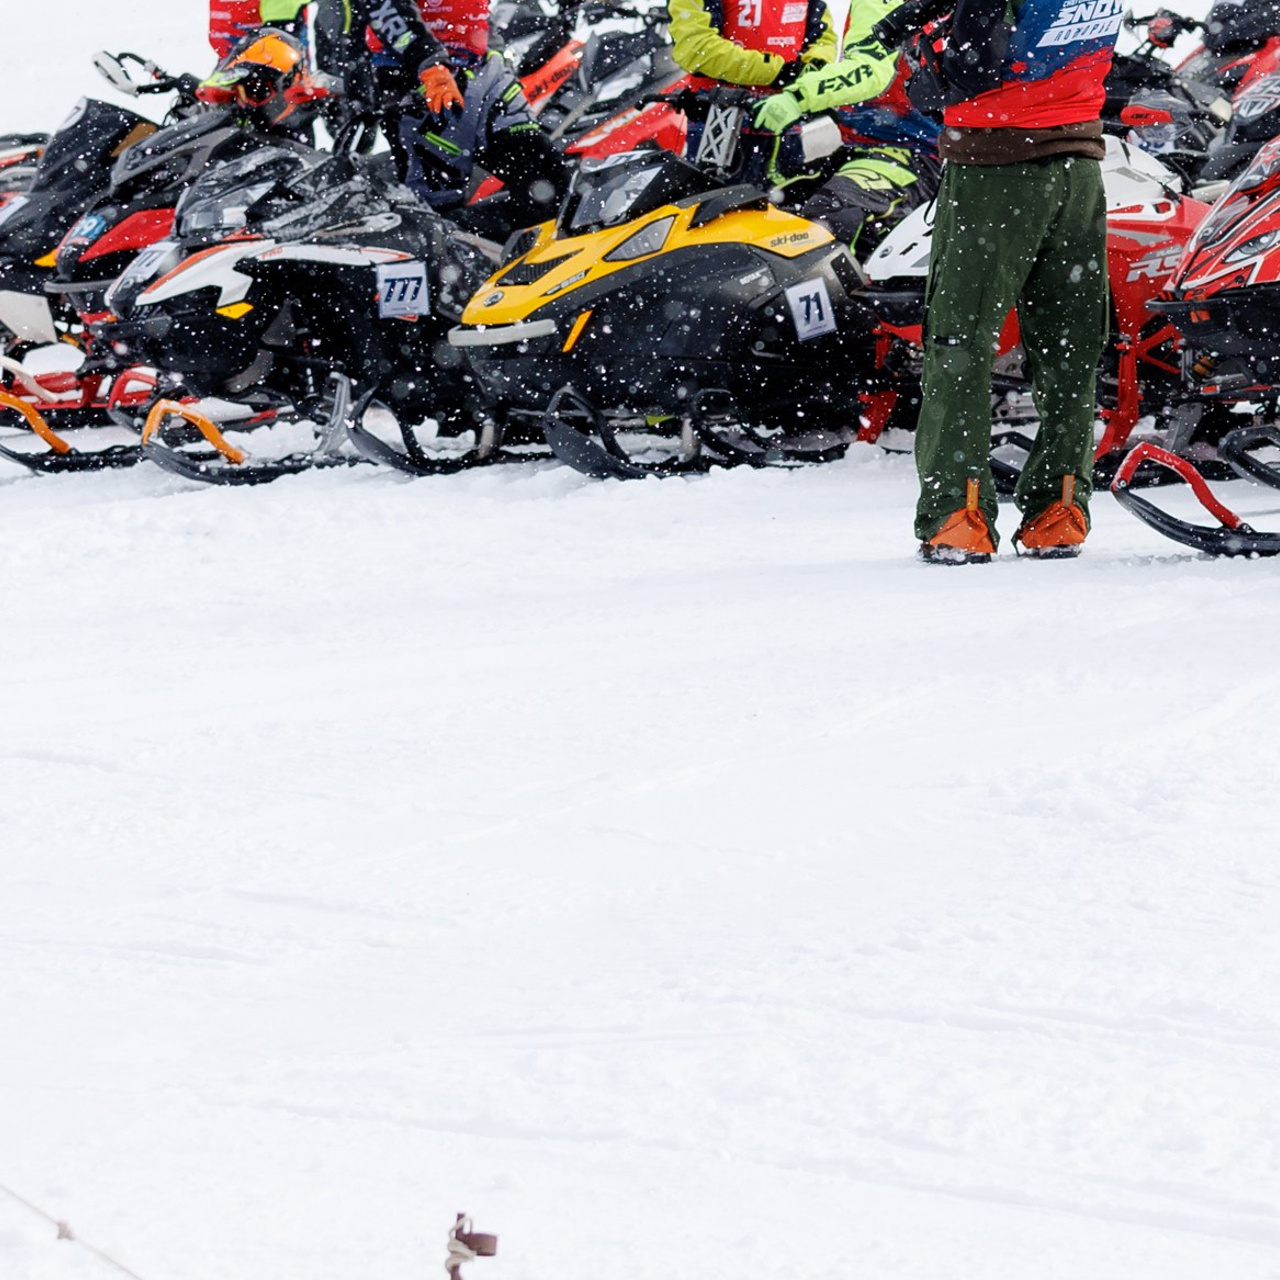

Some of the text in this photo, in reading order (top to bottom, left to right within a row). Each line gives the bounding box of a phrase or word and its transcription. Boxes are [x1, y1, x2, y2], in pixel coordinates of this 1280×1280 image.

[817, 64, 873, 96] FXR
[770, 231, 809, 248] ski-doo
[384, 276, 423, 303] 777
[799, 292, 825, 326] 71
